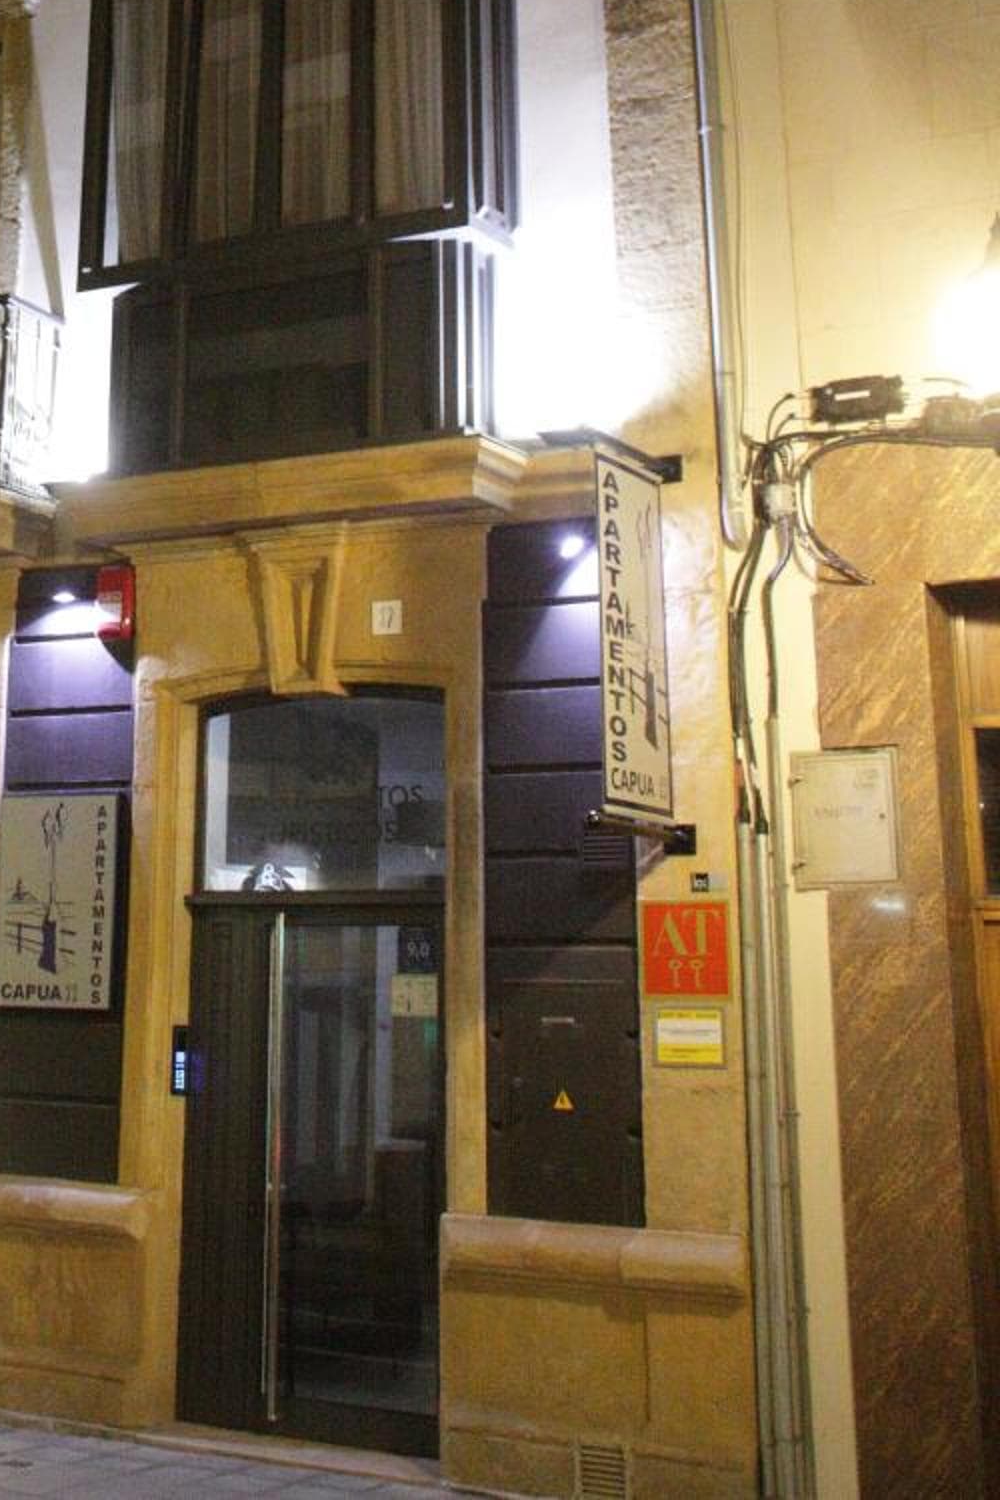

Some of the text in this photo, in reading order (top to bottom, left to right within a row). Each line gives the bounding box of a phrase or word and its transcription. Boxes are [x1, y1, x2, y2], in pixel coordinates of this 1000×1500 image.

[601, 471, 627, 762] APARTAMENTOS
[611, 766, 656, 797] CAPUA
[89, 805, 107, 1005] APARTAMENTOS
[652, 908, 721, 957] AT
[0, 982, 62, 1001] CAPUA
